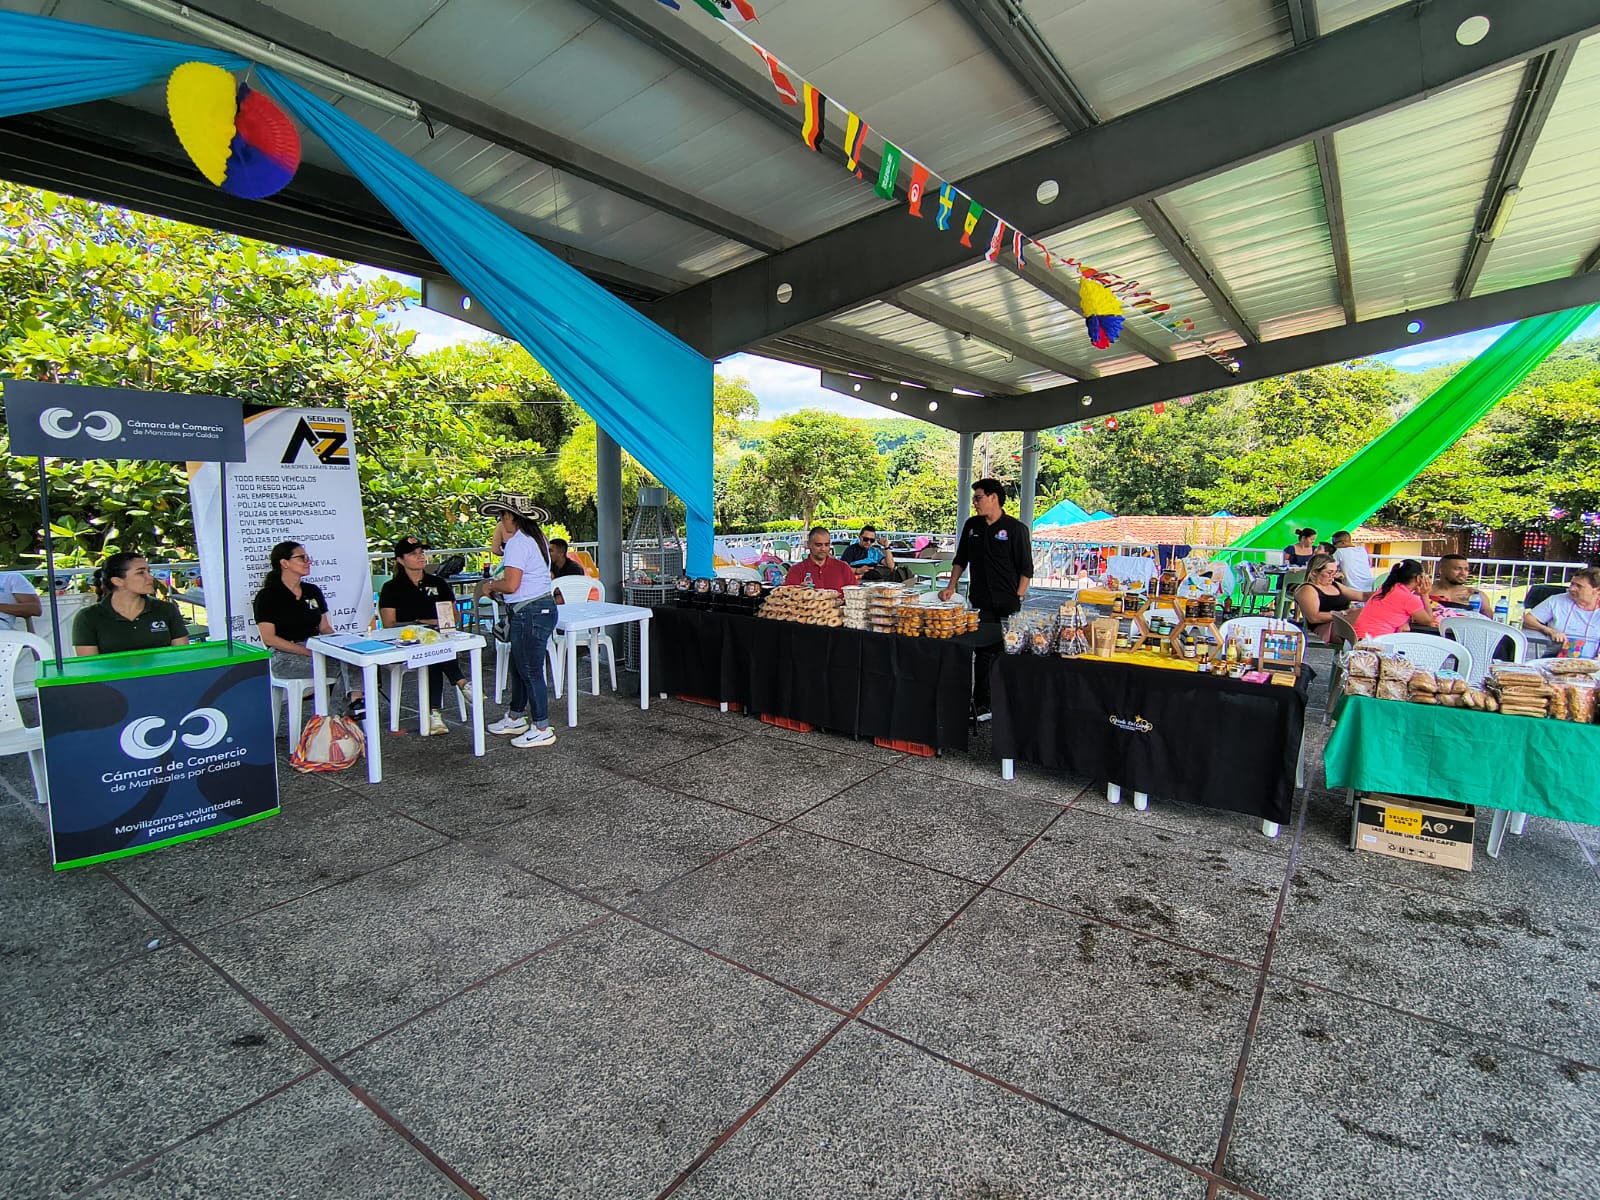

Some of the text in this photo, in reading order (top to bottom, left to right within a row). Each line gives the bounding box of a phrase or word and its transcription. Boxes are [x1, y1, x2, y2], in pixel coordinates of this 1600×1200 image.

[127, 419, 224, 432] Cámara de Comercio
[306, 415, 345, 423] SEGUROS
[144, 429, 181, 437] Manizales
[195, 431, 219, 439] Caldas
[320, 558, 337, 566] VIAJE
[424, 648, 452, 658] SEGUROS
[101, 747, 247, 783] Cámara de Comercio
[110, 760, 241, 793] de Manizales por Caldas
[115, 797, 243, 835] Movilizamos voluntades,
[148, 811, 217, 837] para servirte
